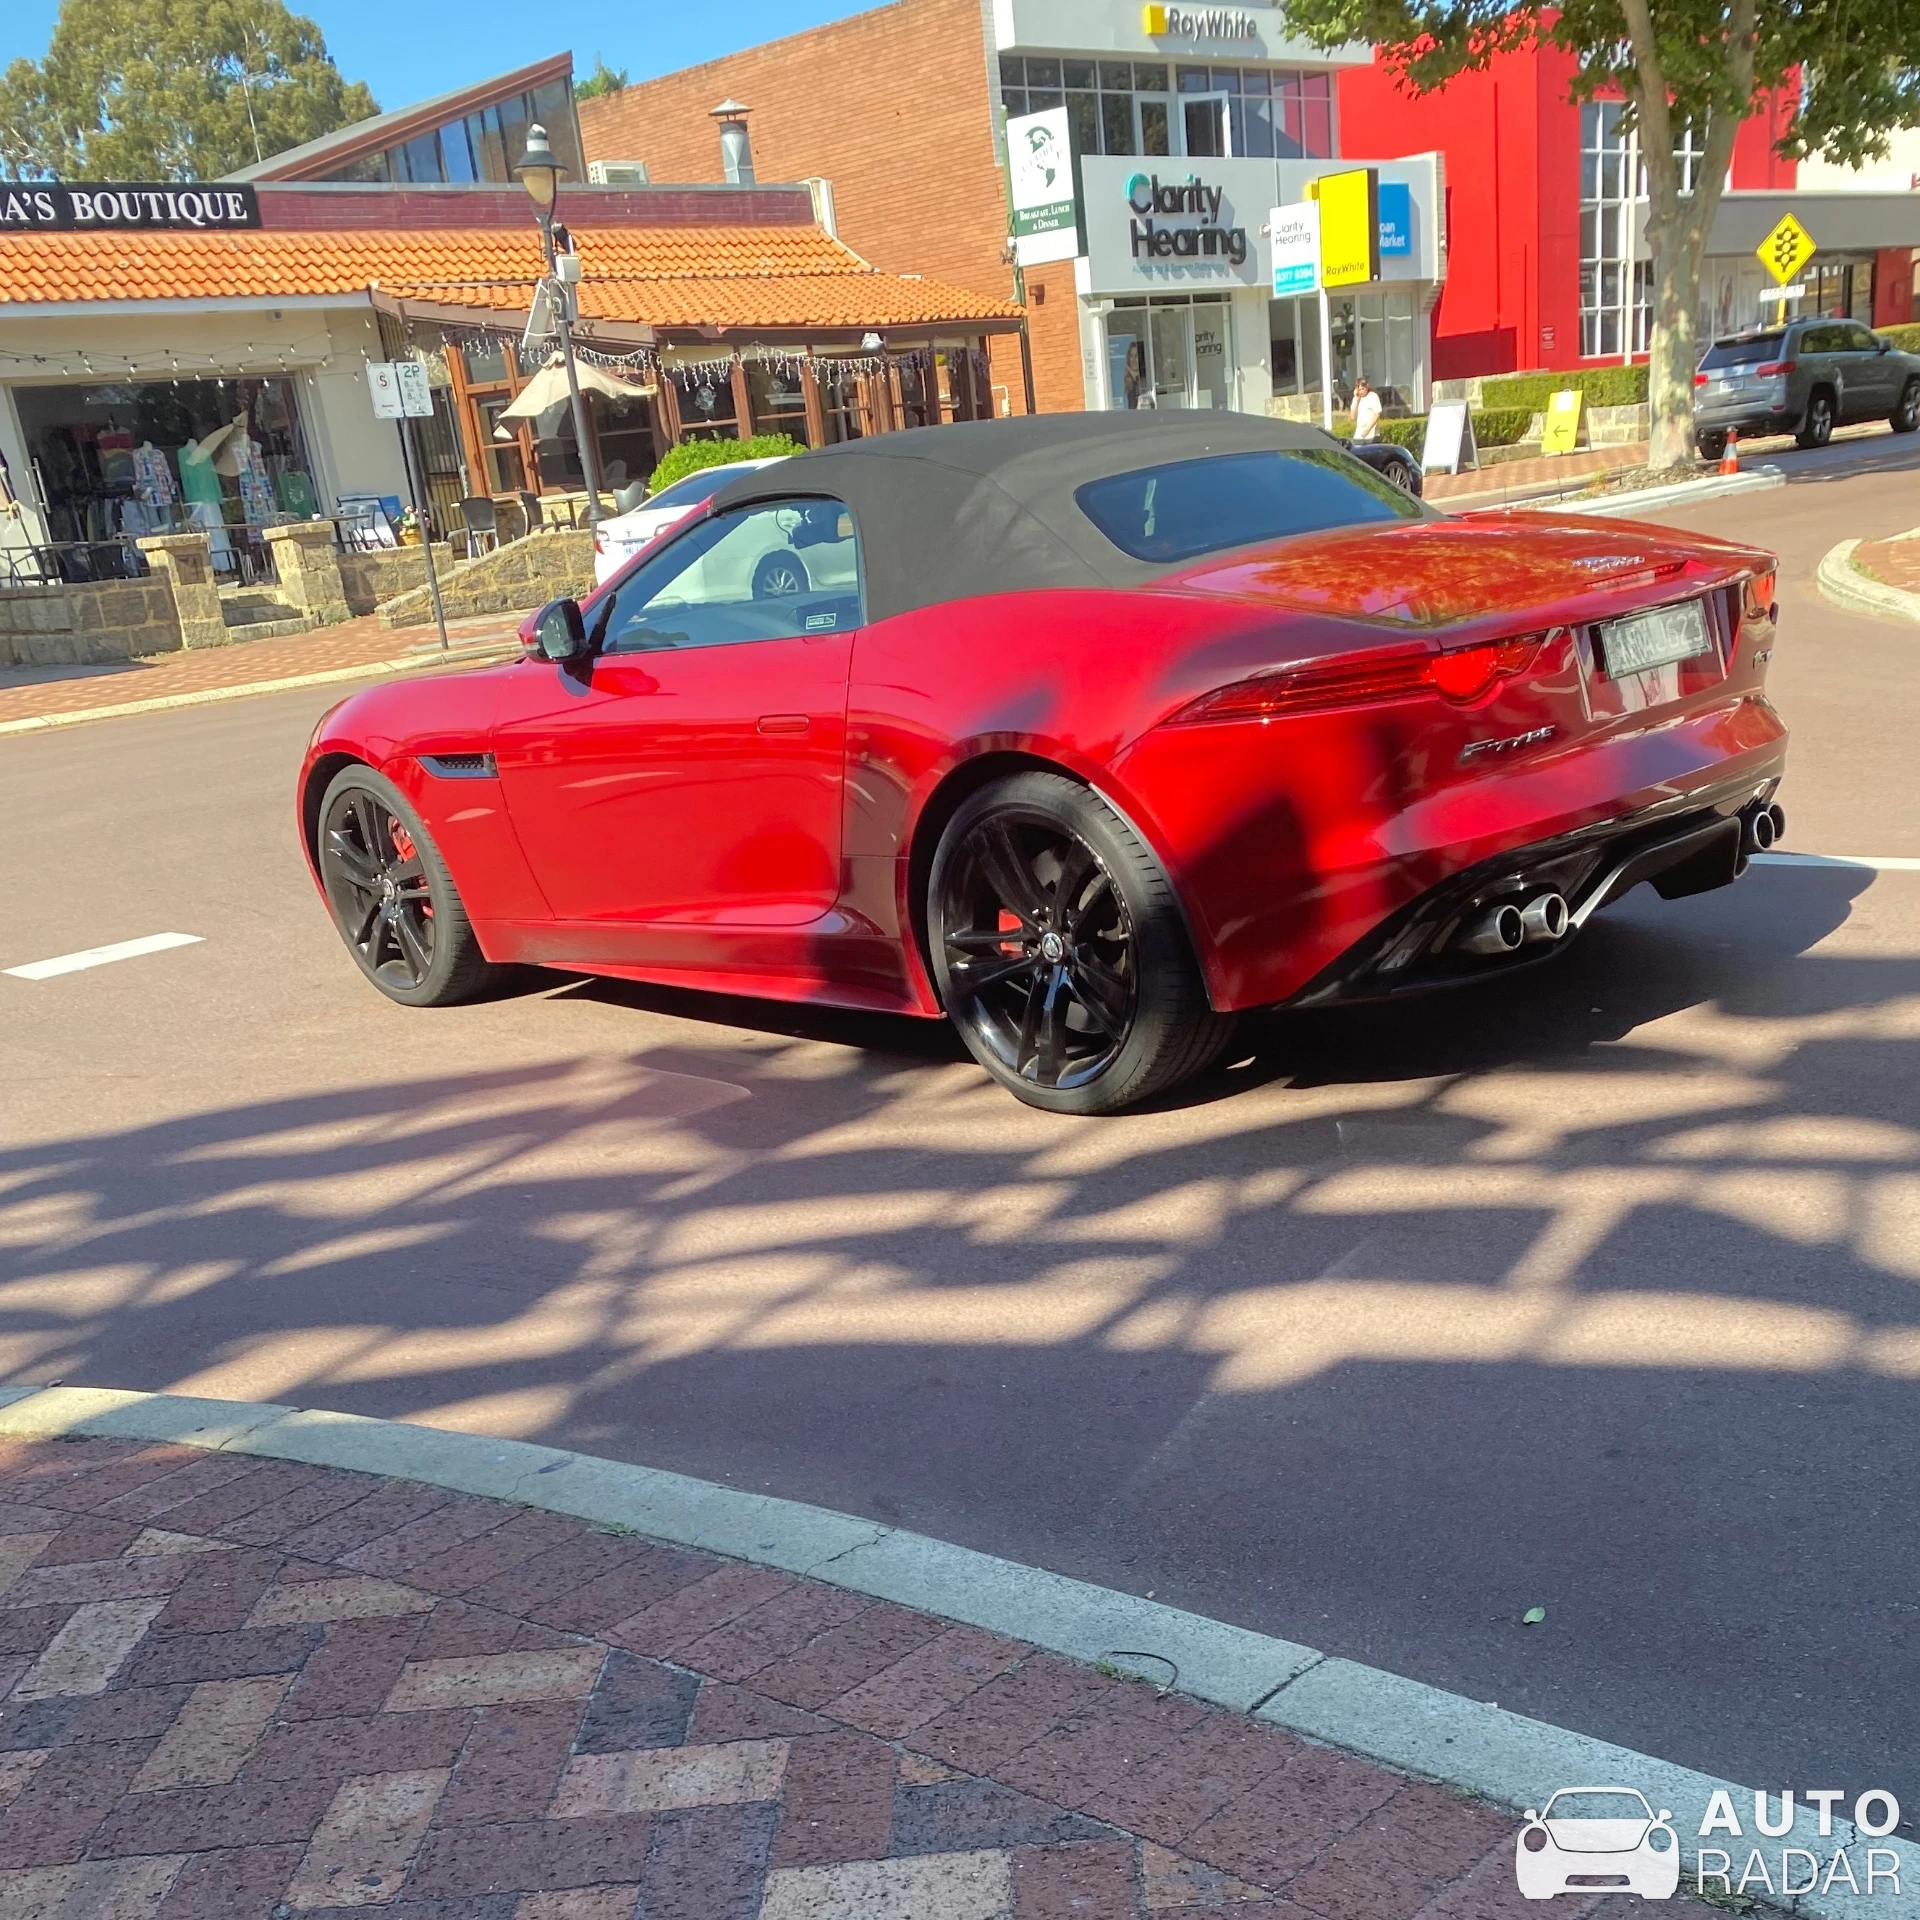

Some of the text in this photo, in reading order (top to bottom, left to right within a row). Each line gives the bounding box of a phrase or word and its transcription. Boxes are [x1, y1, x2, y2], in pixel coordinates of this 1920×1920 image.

[1126, 173, 1222, 223] Clarity
[0, 191, 248, 225] A'S BOUTIQUE
[1379, 222, 1396, 233] oan
[1129, 217, 1247, 265] Hearing
[1275, 231, 1311, 245] Hearing
[1195, 330, 1215, 344] arity
[1196, 343, 1222, 355] earing
[403, 364, 420, 378] 2P
